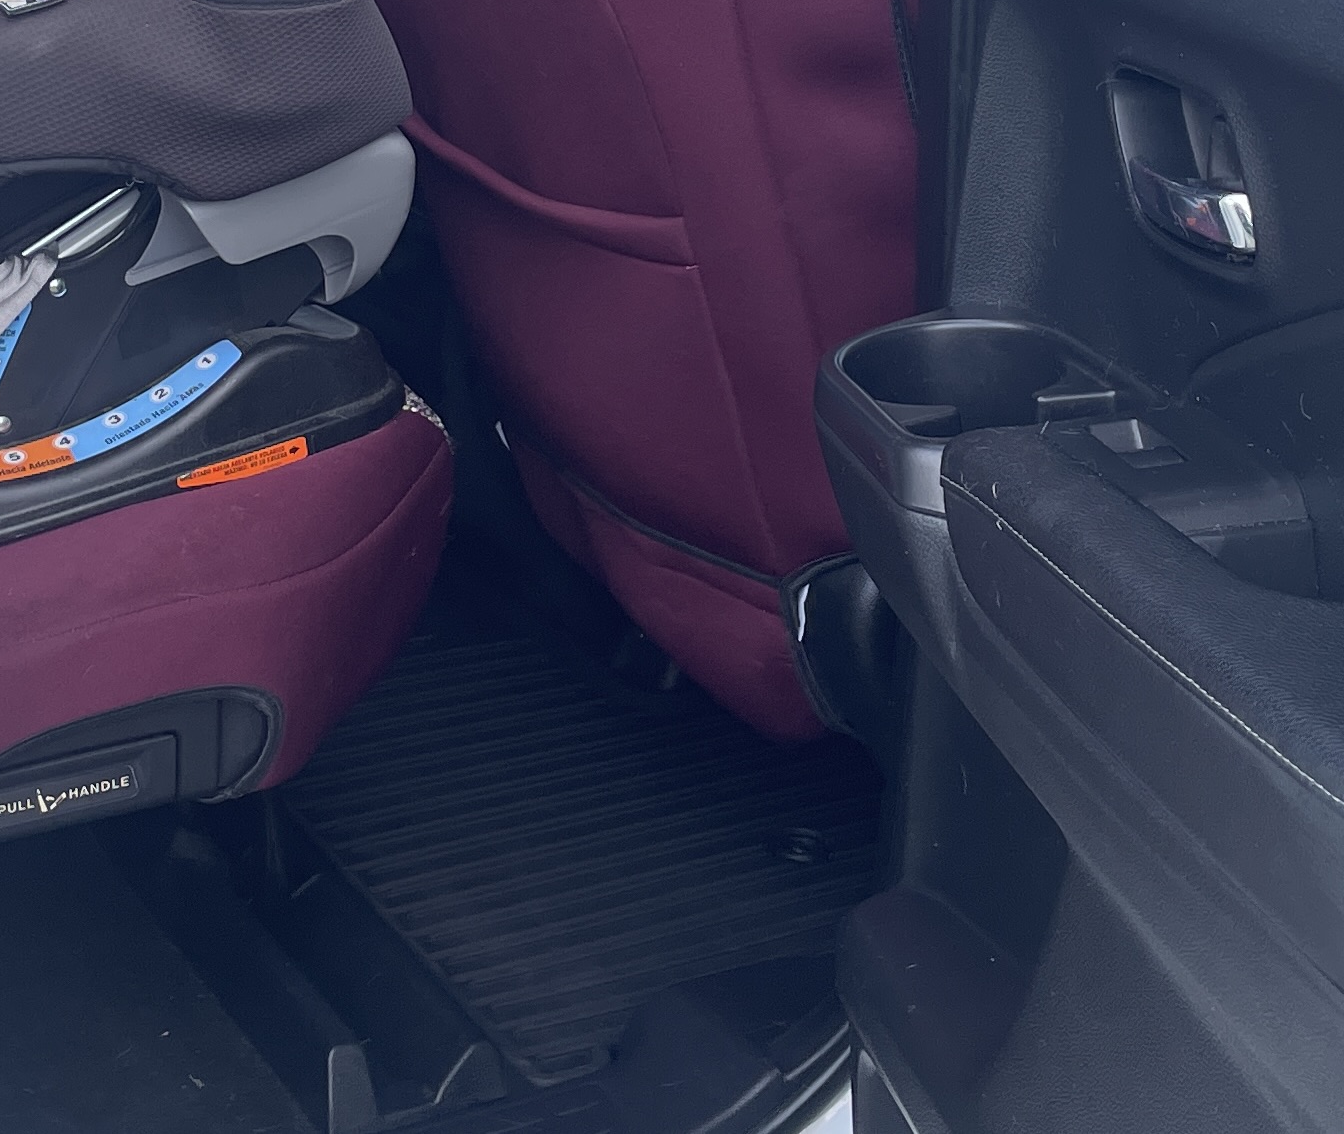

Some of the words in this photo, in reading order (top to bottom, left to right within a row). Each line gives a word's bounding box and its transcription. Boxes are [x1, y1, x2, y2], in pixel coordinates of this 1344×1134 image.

[202, 356, 211, 364] 1
[154, 388, 168, 400] 2
[104, 417, 151, 445] Orientado
[151, 400, 179, 419] Hacia
[108, 414, 121, 424] 3
[60, 436, 71, 445] 4
[9, 452, 20, 461] 5
[29, 454, 71, 469] Adelante
[231, 454, 258, 465] ADELANTE
[68, 776, 130, 800] HANDLE
